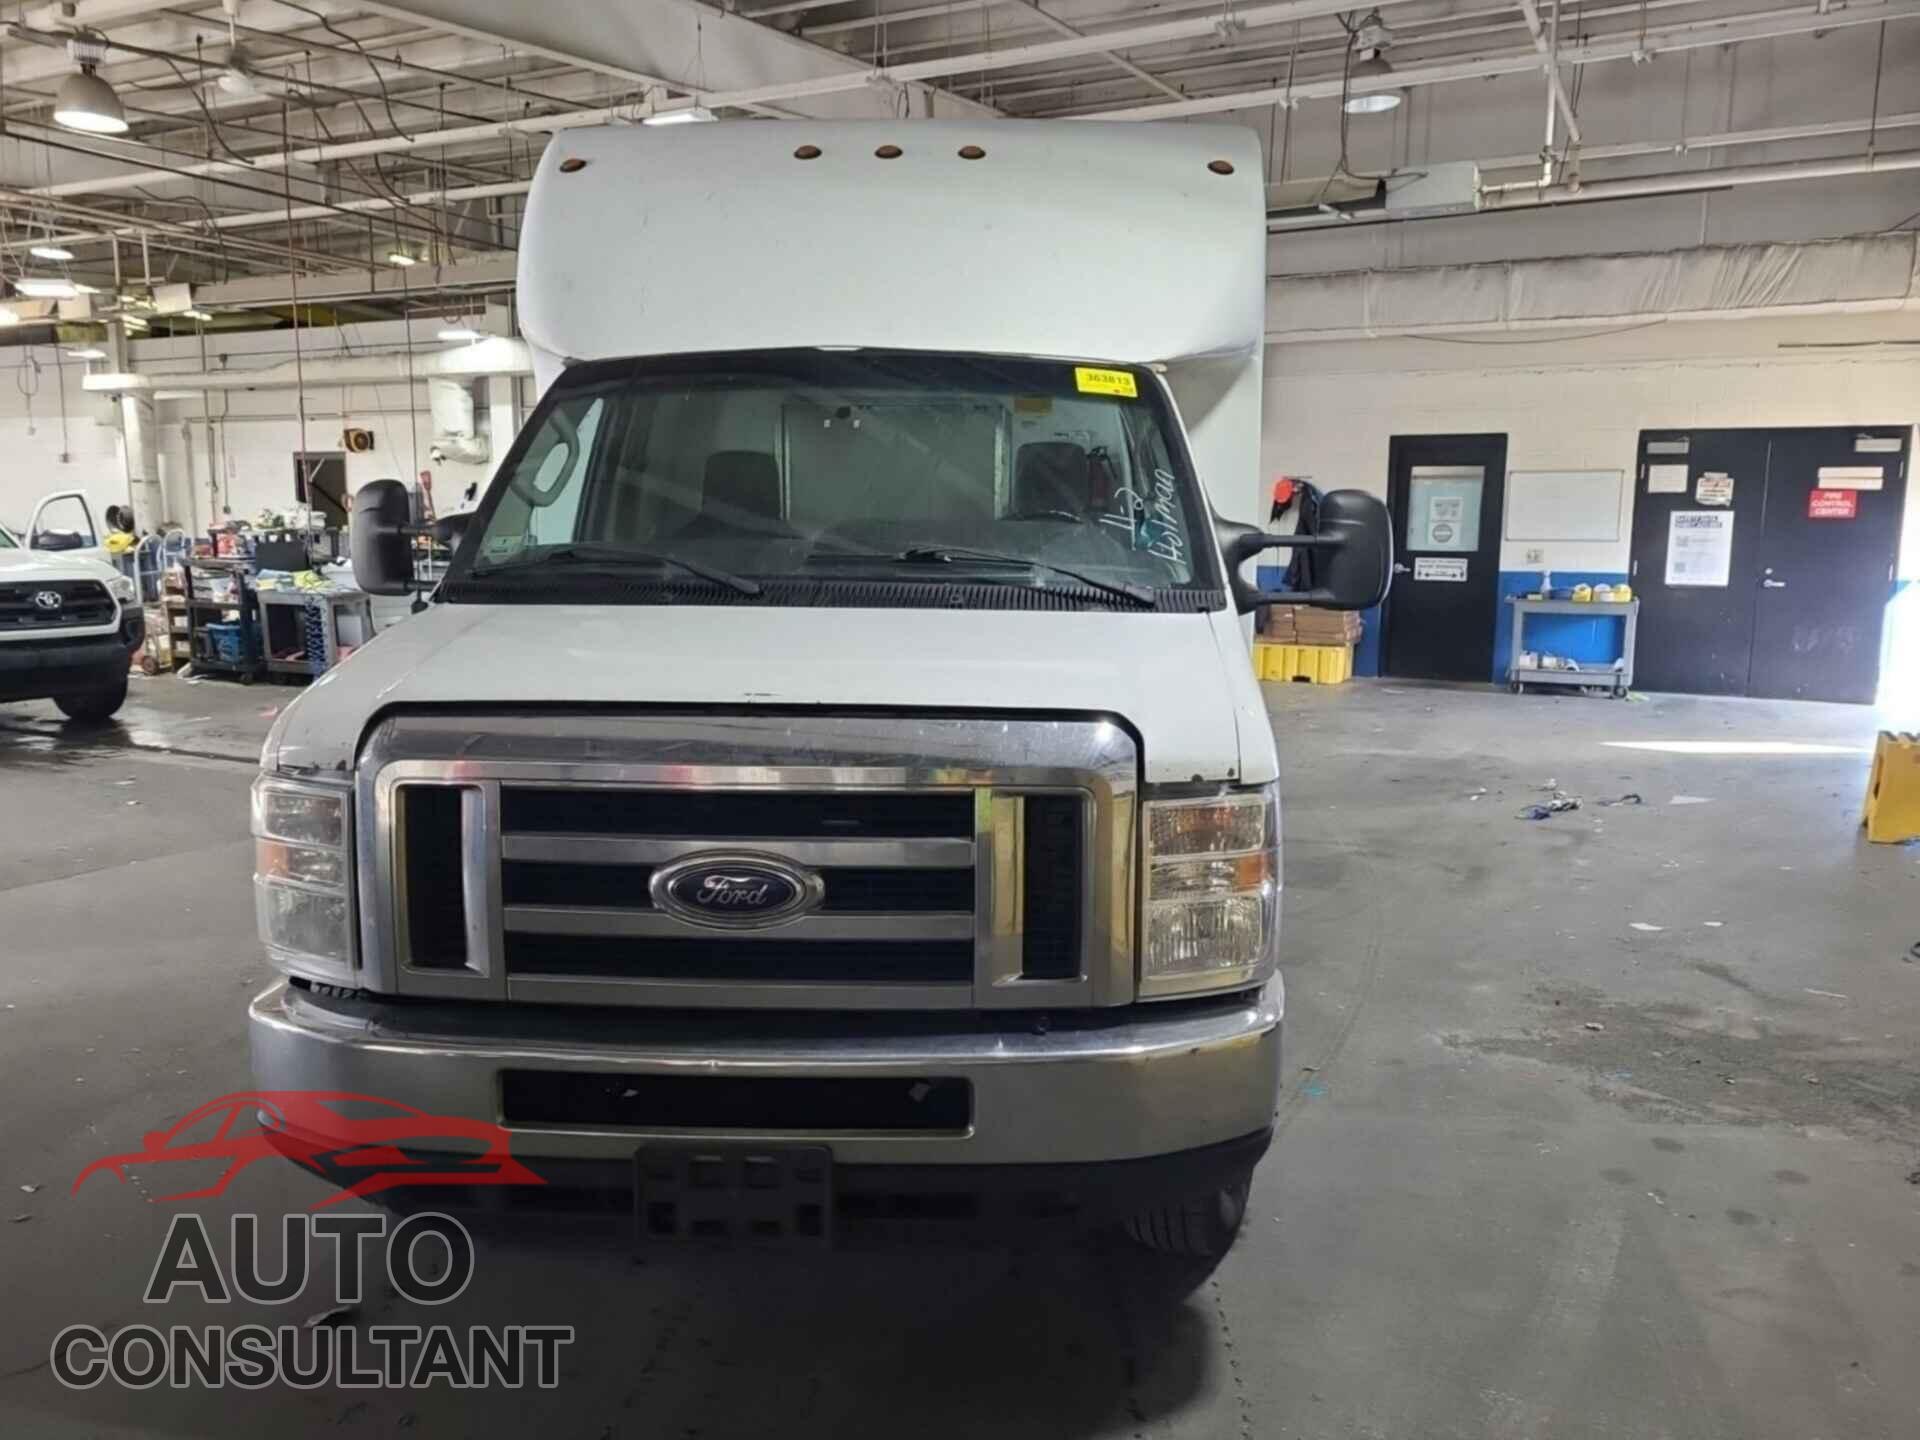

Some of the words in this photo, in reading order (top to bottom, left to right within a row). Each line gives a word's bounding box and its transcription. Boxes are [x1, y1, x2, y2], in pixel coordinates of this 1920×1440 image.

[1811, 499, 1853, 508] CONTROL
[1814, 507, 1850, 516] CENTER
[696, 874, 769, 906] Ford
